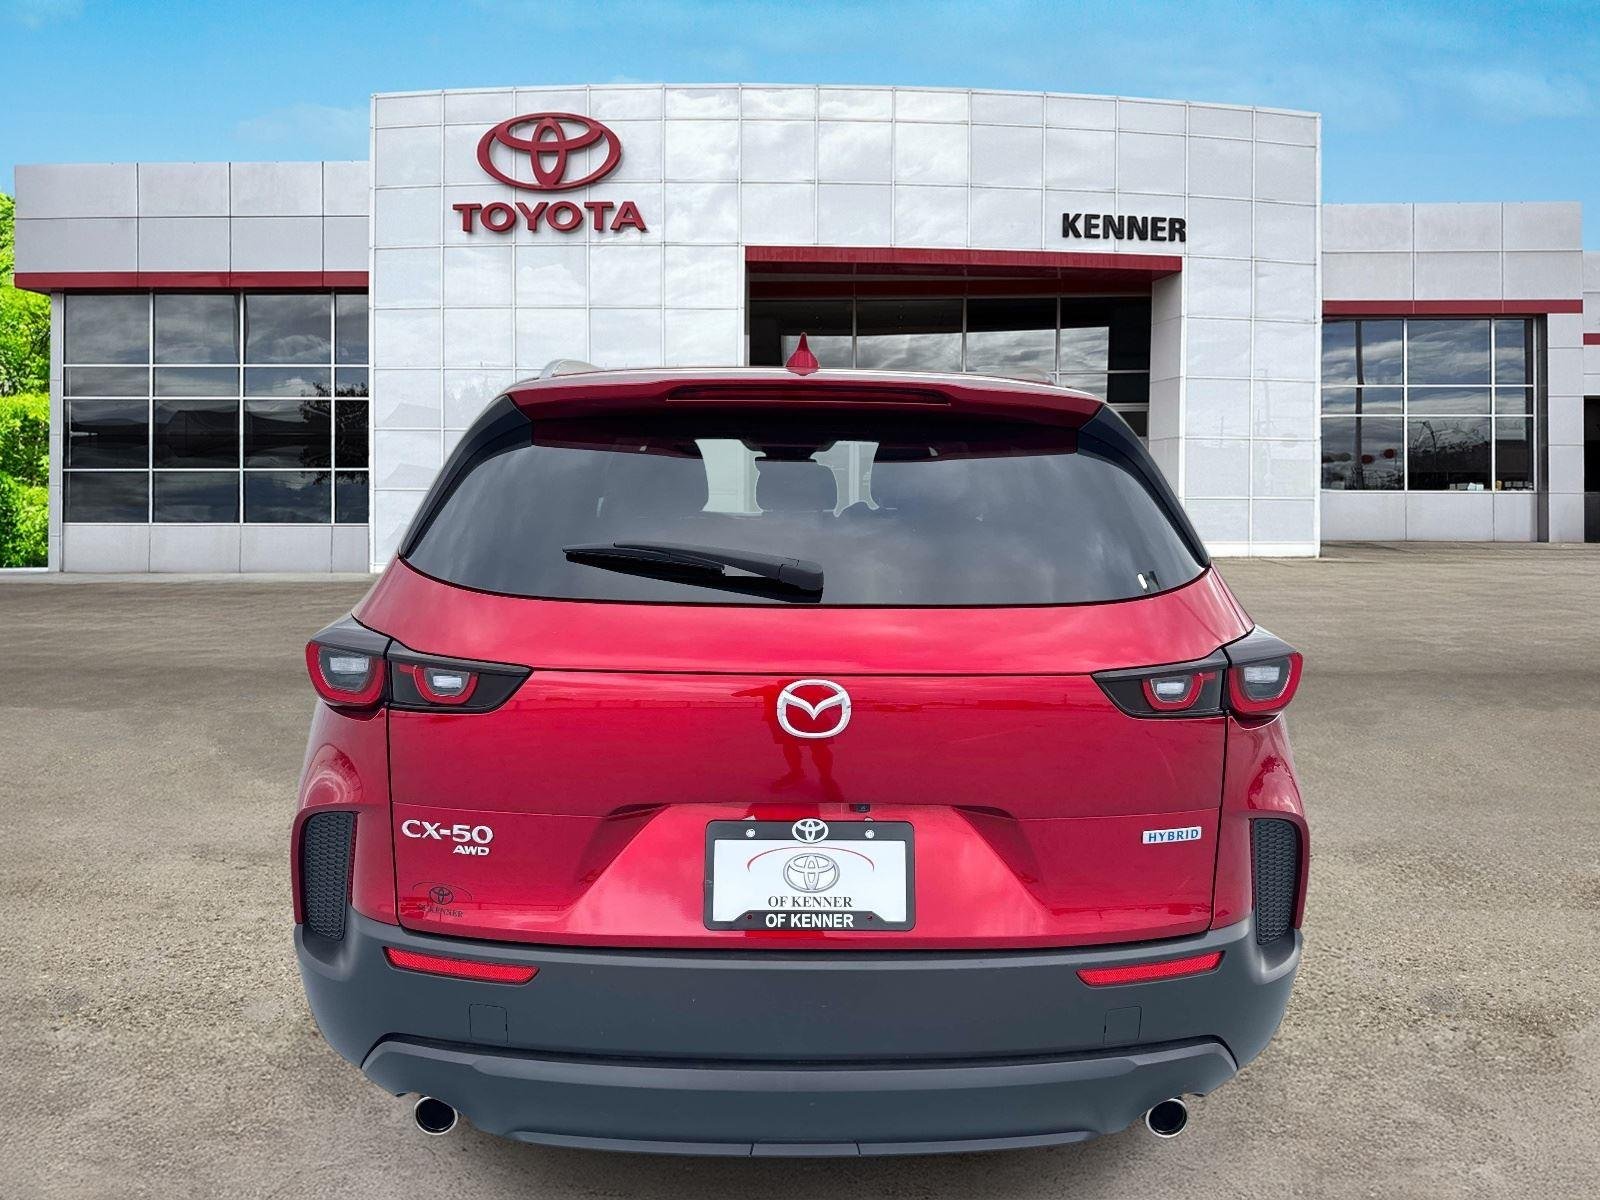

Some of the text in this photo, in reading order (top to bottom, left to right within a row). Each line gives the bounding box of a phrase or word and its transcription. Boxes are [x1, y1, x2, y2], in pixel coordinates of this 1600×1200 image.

[452, 201, 647, 233] TOYOTA
[1062, 213, 1187, 242] KENNER
[401, 819, 494, 844] CX-50
[1148, 829, 1199, 842] HYBRID
[453, 844, 490, 856] AWD
[768, 896, 853, 908] OF KENNER
[765, 913, 854, 928] OF KENNER
